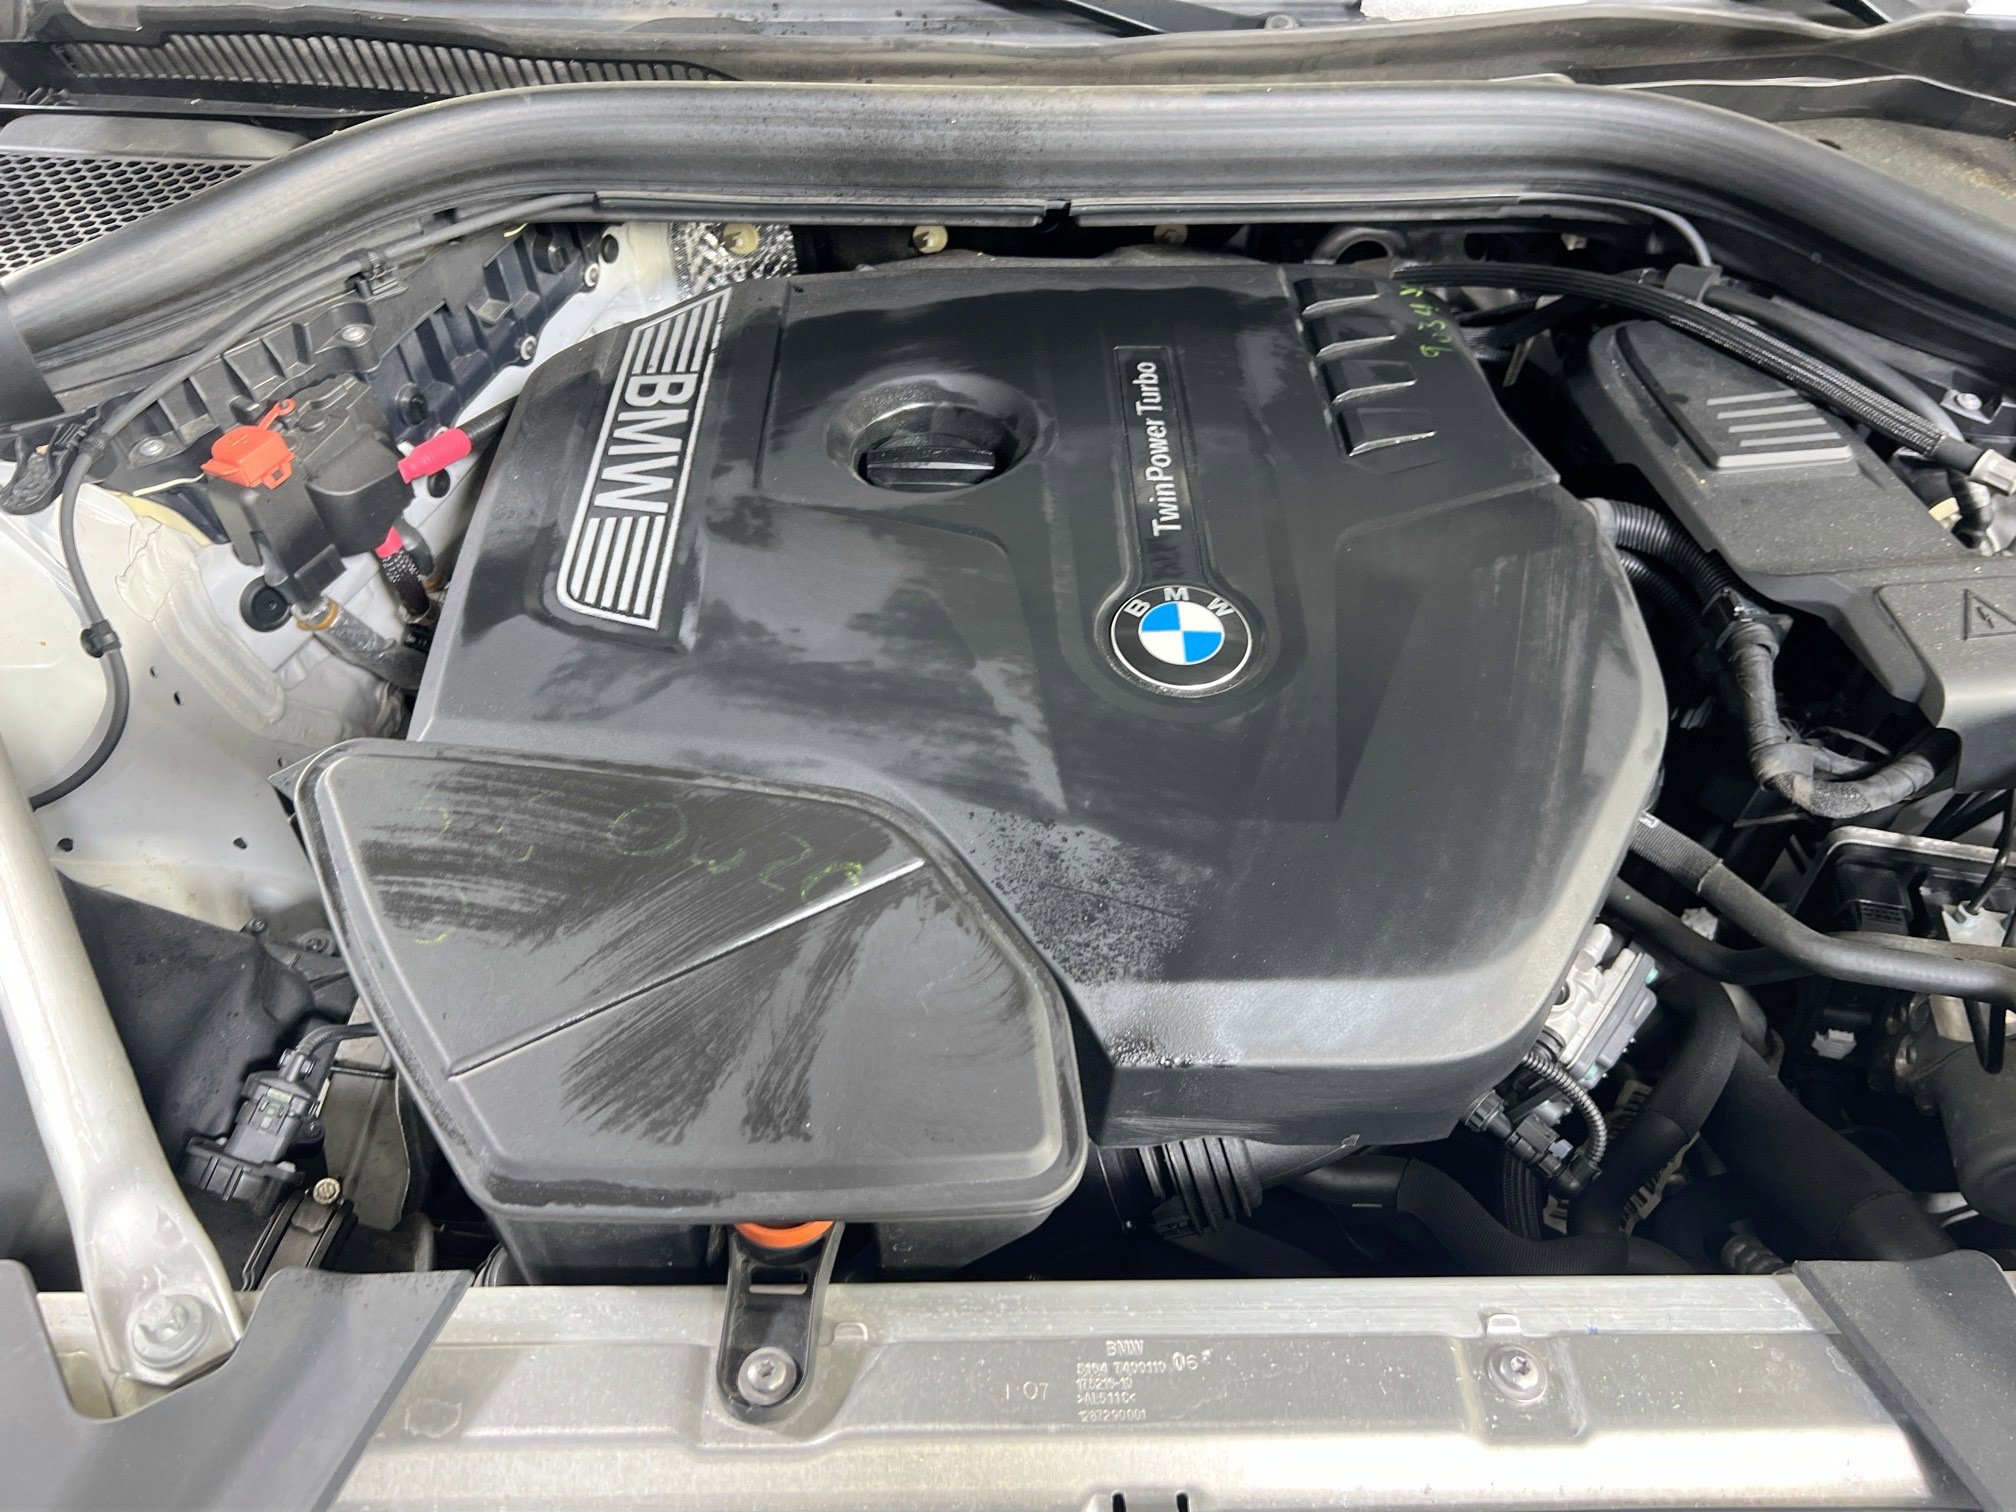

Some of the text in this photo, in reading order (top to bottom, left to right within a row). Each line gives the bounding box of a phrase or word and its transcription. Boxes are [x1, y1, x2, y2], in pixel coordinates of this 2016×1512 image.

[593, 373, 698, 514] BMW
[1132, 361, 1182, 537] TwinPower Turbo
[1123, 586, 1236, 618] BMW
[1105, 1339, 1144, 1357] BMW
